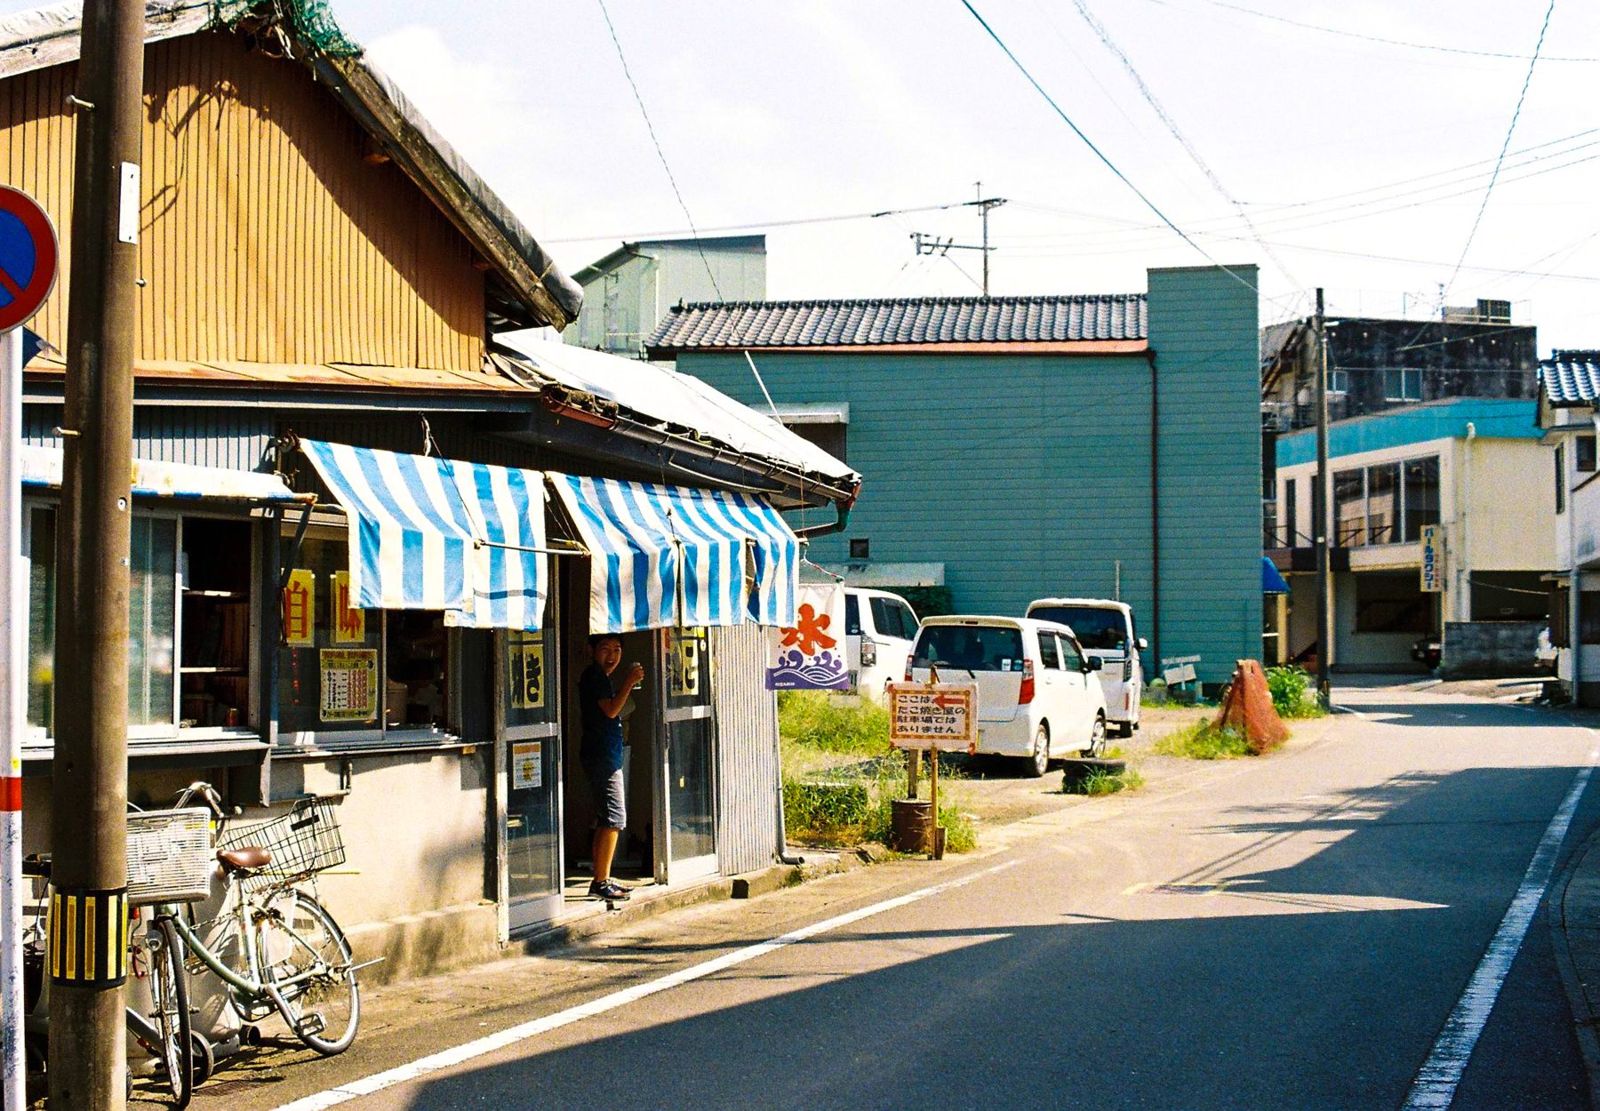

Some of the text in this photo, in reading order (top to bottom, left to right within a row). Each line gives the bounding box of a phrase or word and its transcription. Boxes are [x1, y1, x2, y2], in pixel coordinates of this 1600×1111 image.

[781, 603, 837, 656] 氷
[897, 706, 966, 715] たこ焼き屋の
[897, 716, 957, 724] 駐車場では
[897, 726, 961, 734] ありません。
